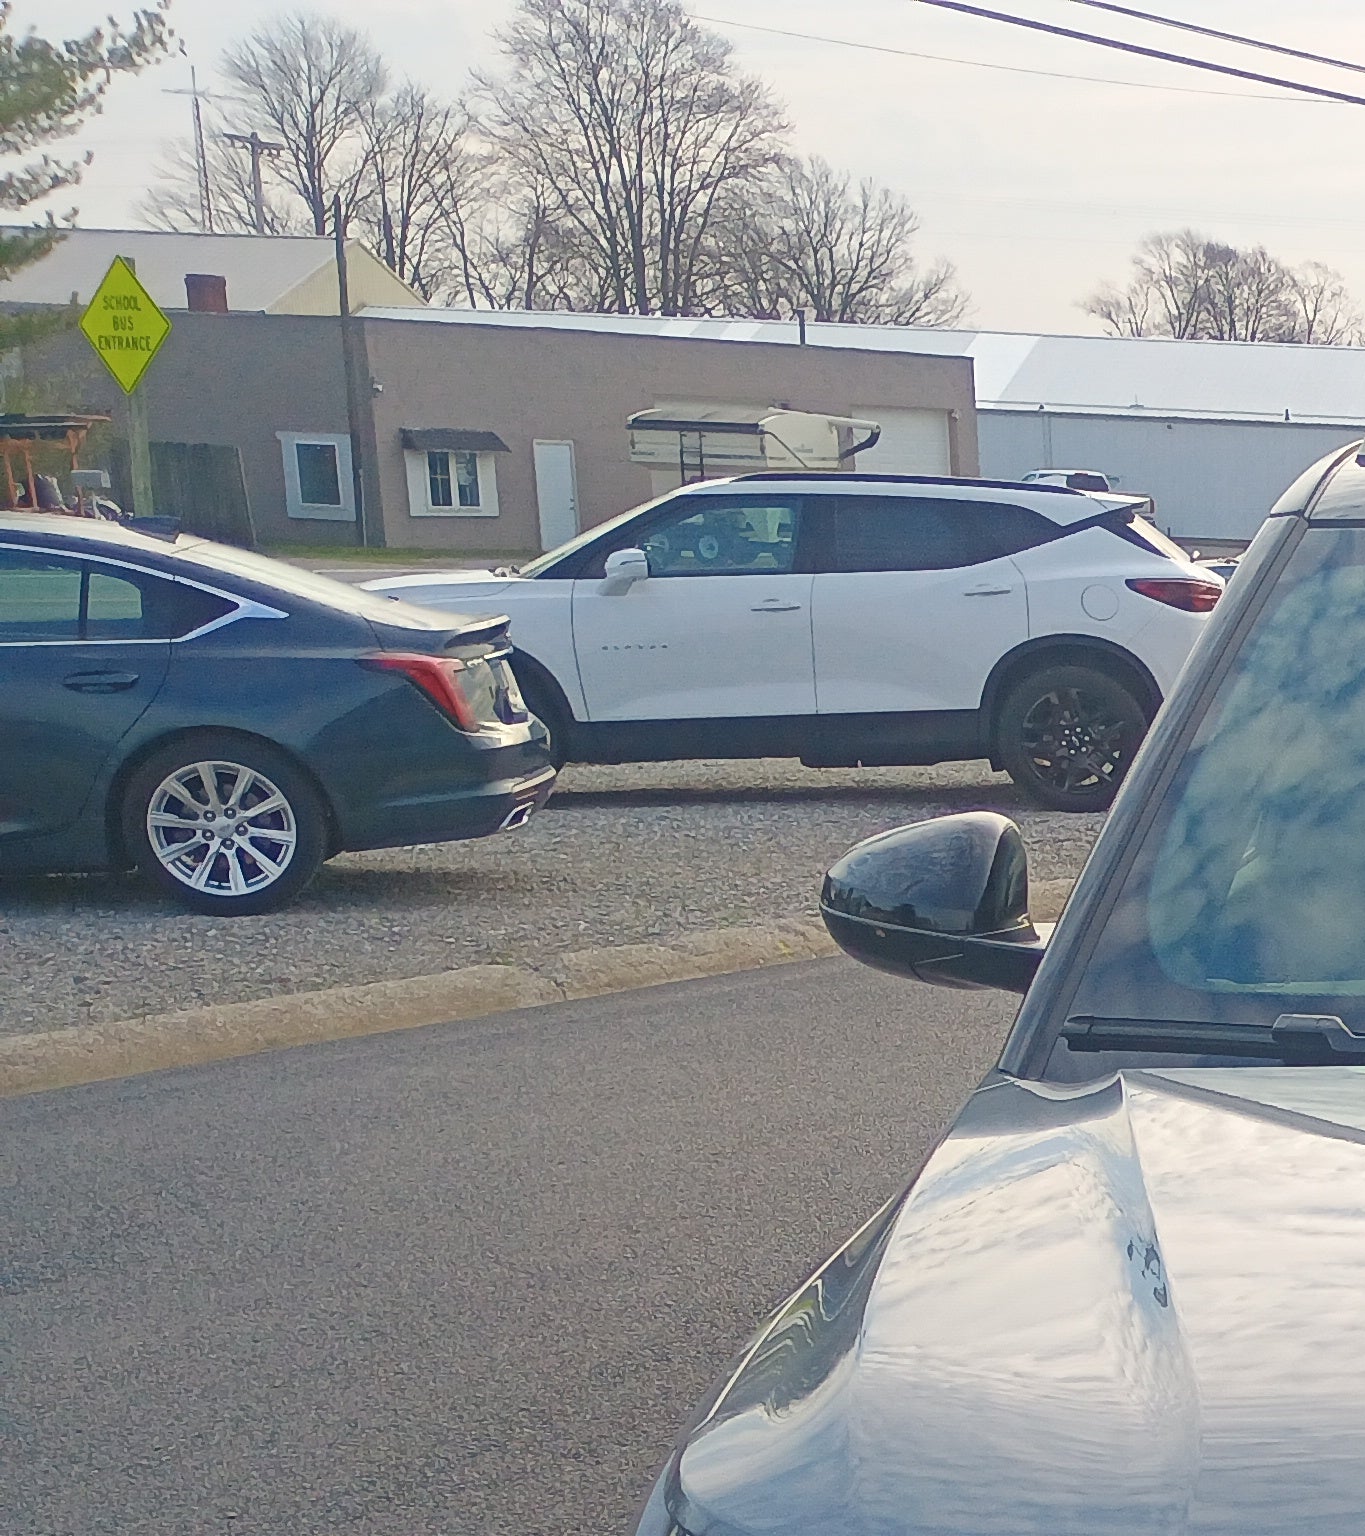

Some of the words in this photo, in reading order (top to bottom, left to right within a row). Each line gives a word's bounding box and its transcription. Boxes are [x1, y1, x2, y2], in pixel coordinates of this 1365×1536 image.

[103, 295, 141, 311] SCHOOL
[112, 315, 134, 331] BUS
[98, 335, 151, 351] ENTRANCE
